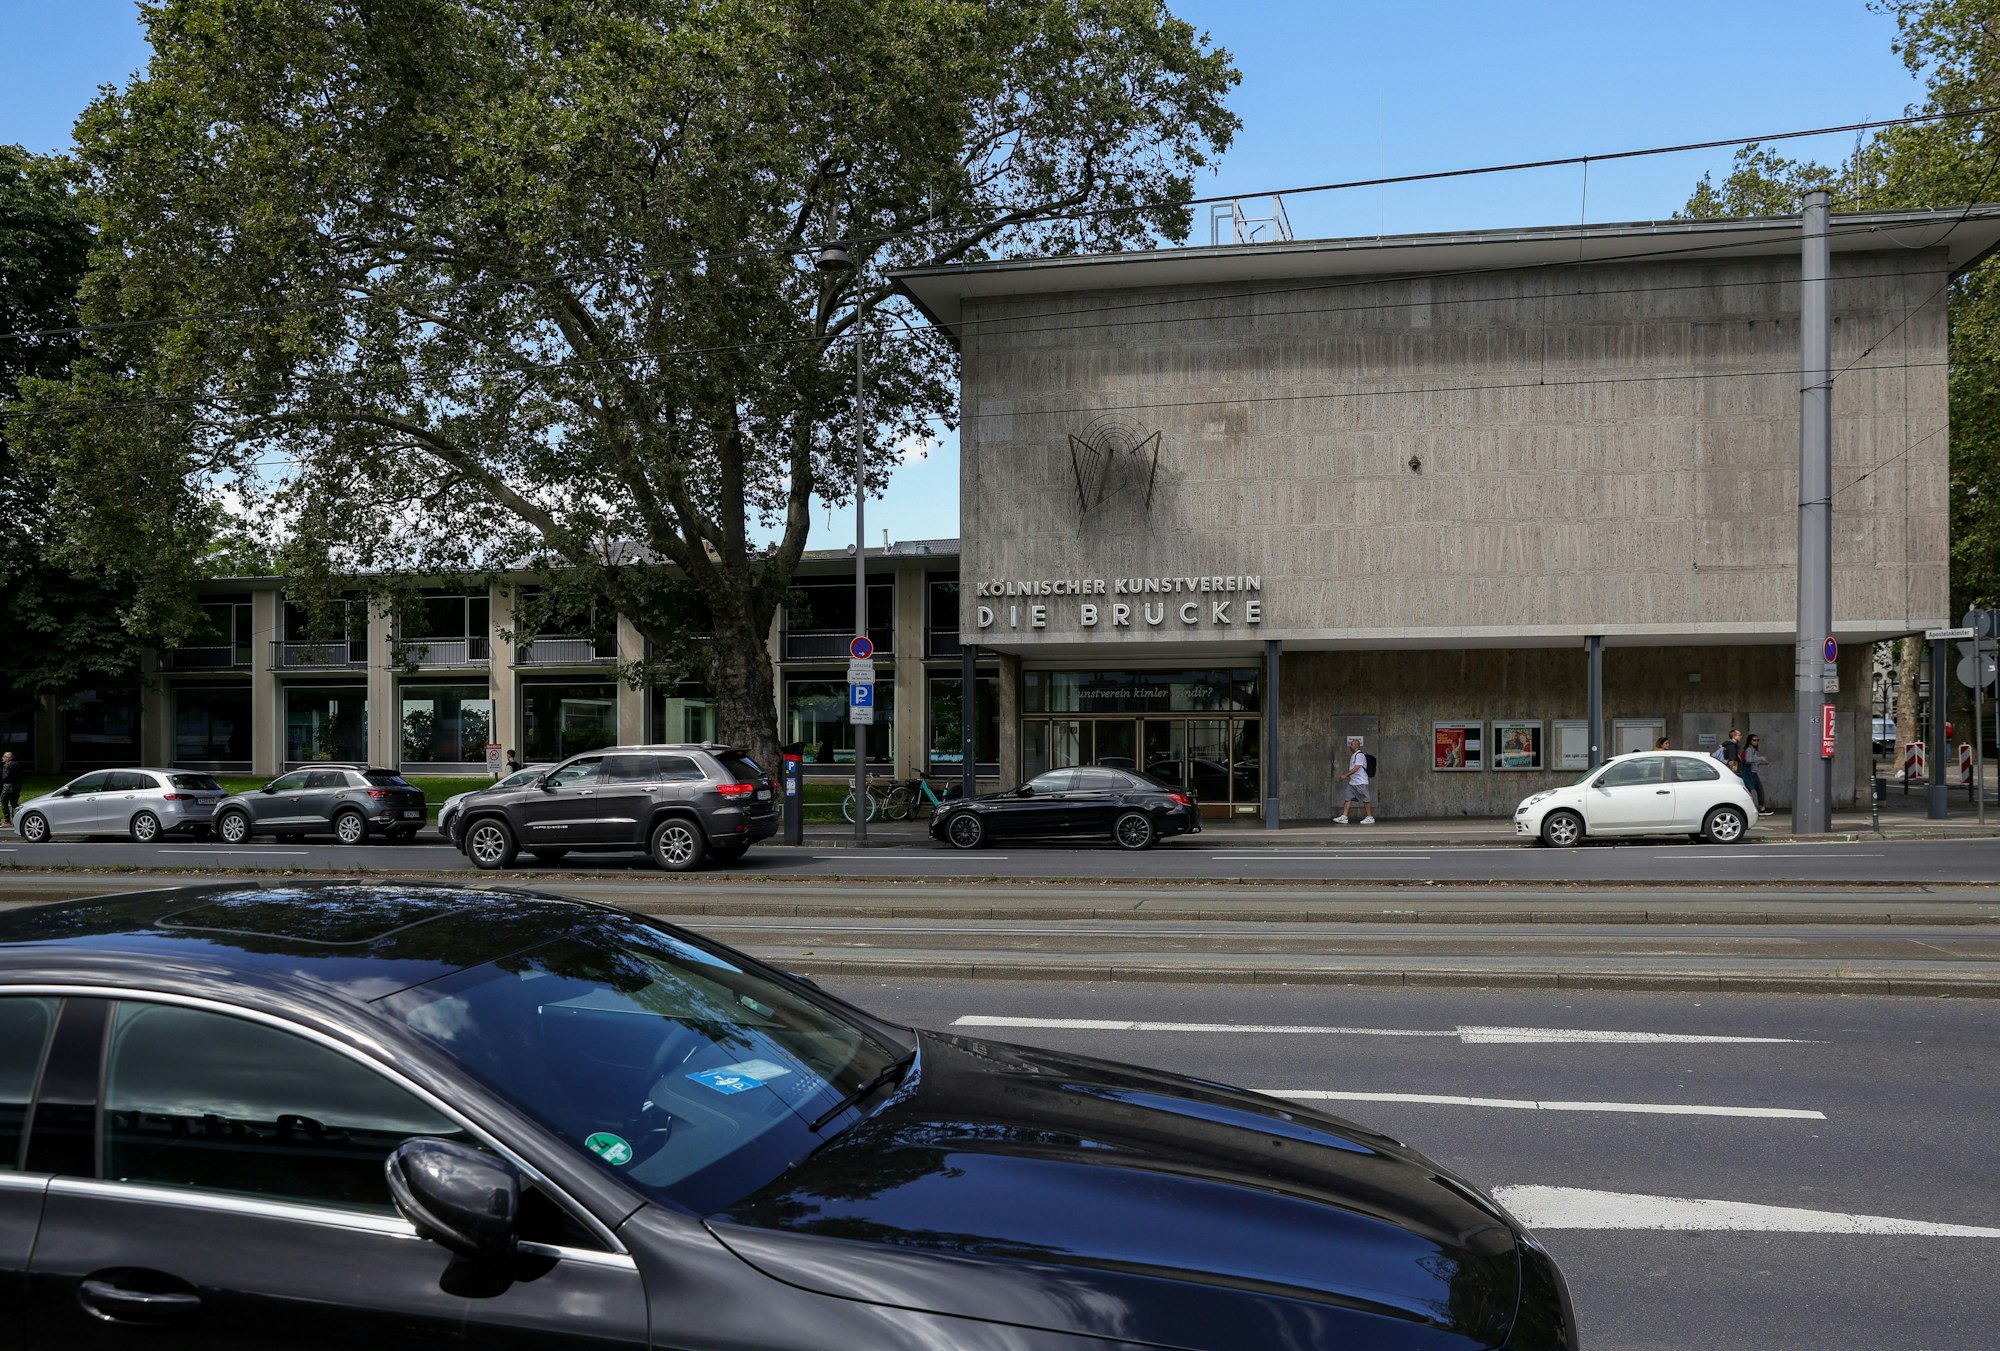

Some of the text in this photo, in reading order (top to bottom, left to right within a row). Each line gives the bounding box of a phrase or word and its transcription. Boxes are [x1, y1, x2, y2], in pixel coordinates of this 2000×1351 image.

[977, 575, 1261, 597] KÖLNISCHER KUNSTVEREIN
[977, 600, 1261, 628] DIE BRÜCKE
[855, 686, 868, 704] P
[1134, 688, 1168, 698] kimler
[1170, 687, 1213, 698] indir?
[788, 761, 795, 770] P
[593, 1137, 611, 1149] 4
